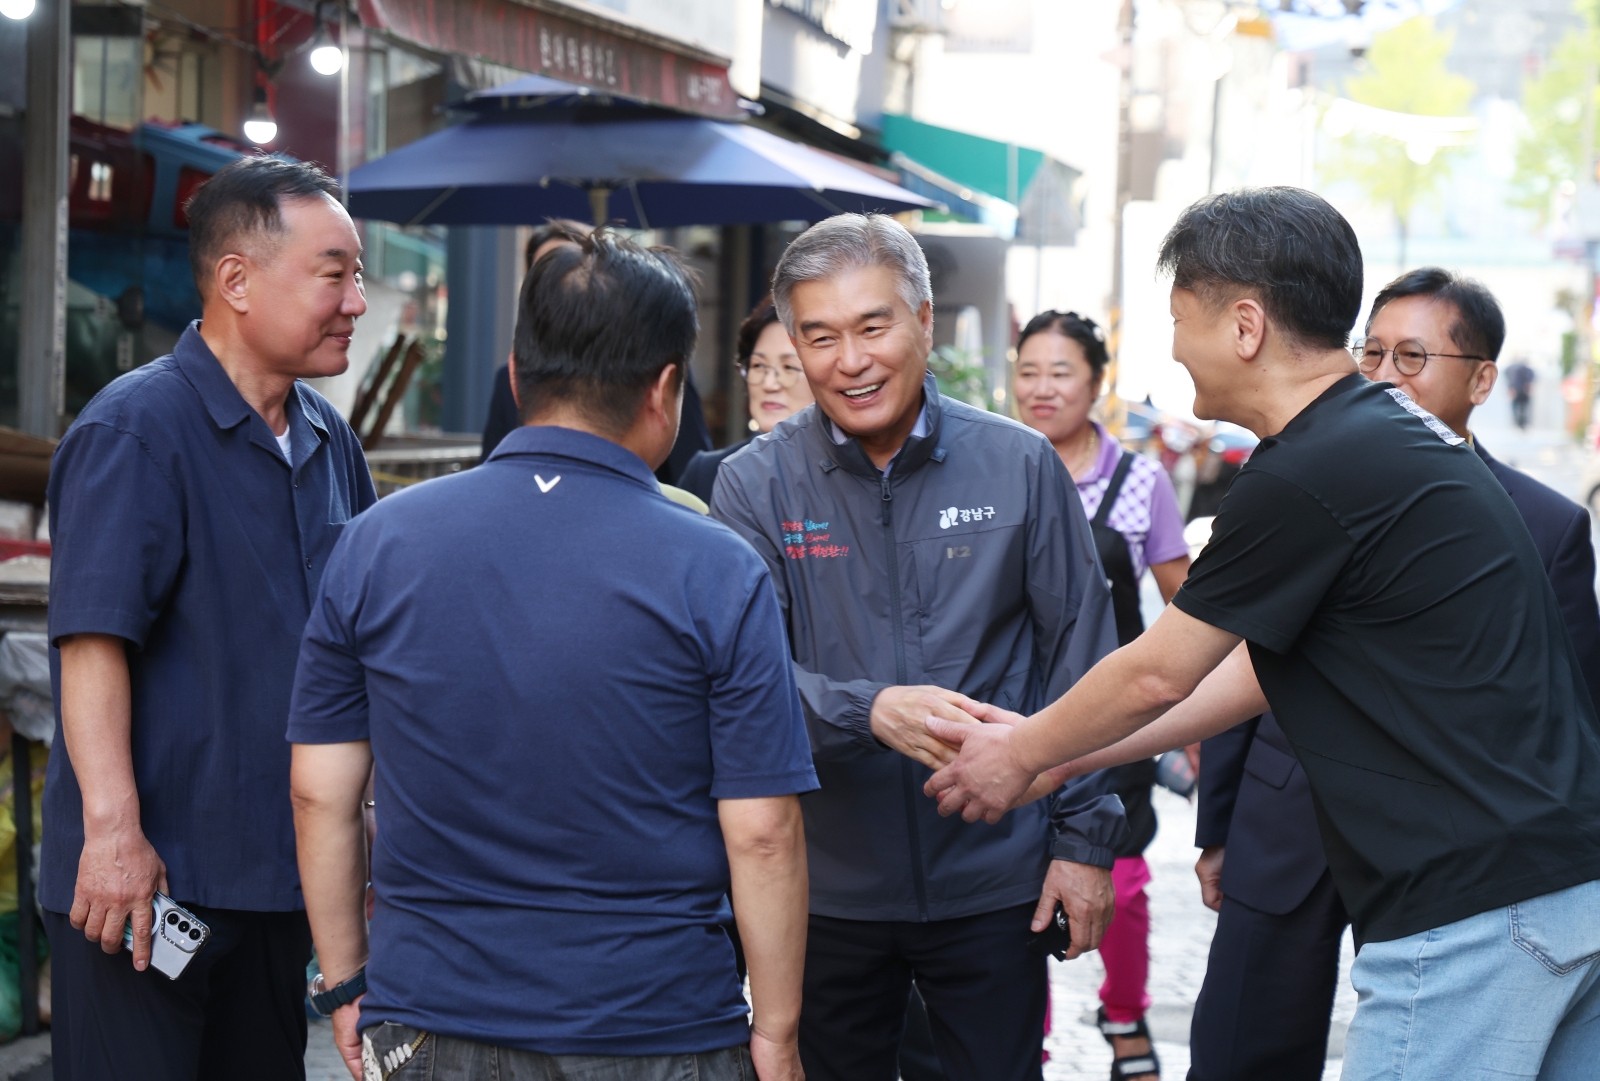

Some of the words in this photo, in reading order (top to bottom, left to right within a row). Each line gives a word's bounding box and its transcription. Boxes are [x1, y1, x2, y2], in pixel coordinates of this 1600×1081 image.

[959, 506, 995, 522] 강남구
[785, 544, 806, 559] 강남
[947, 546, 972, 559] K2
